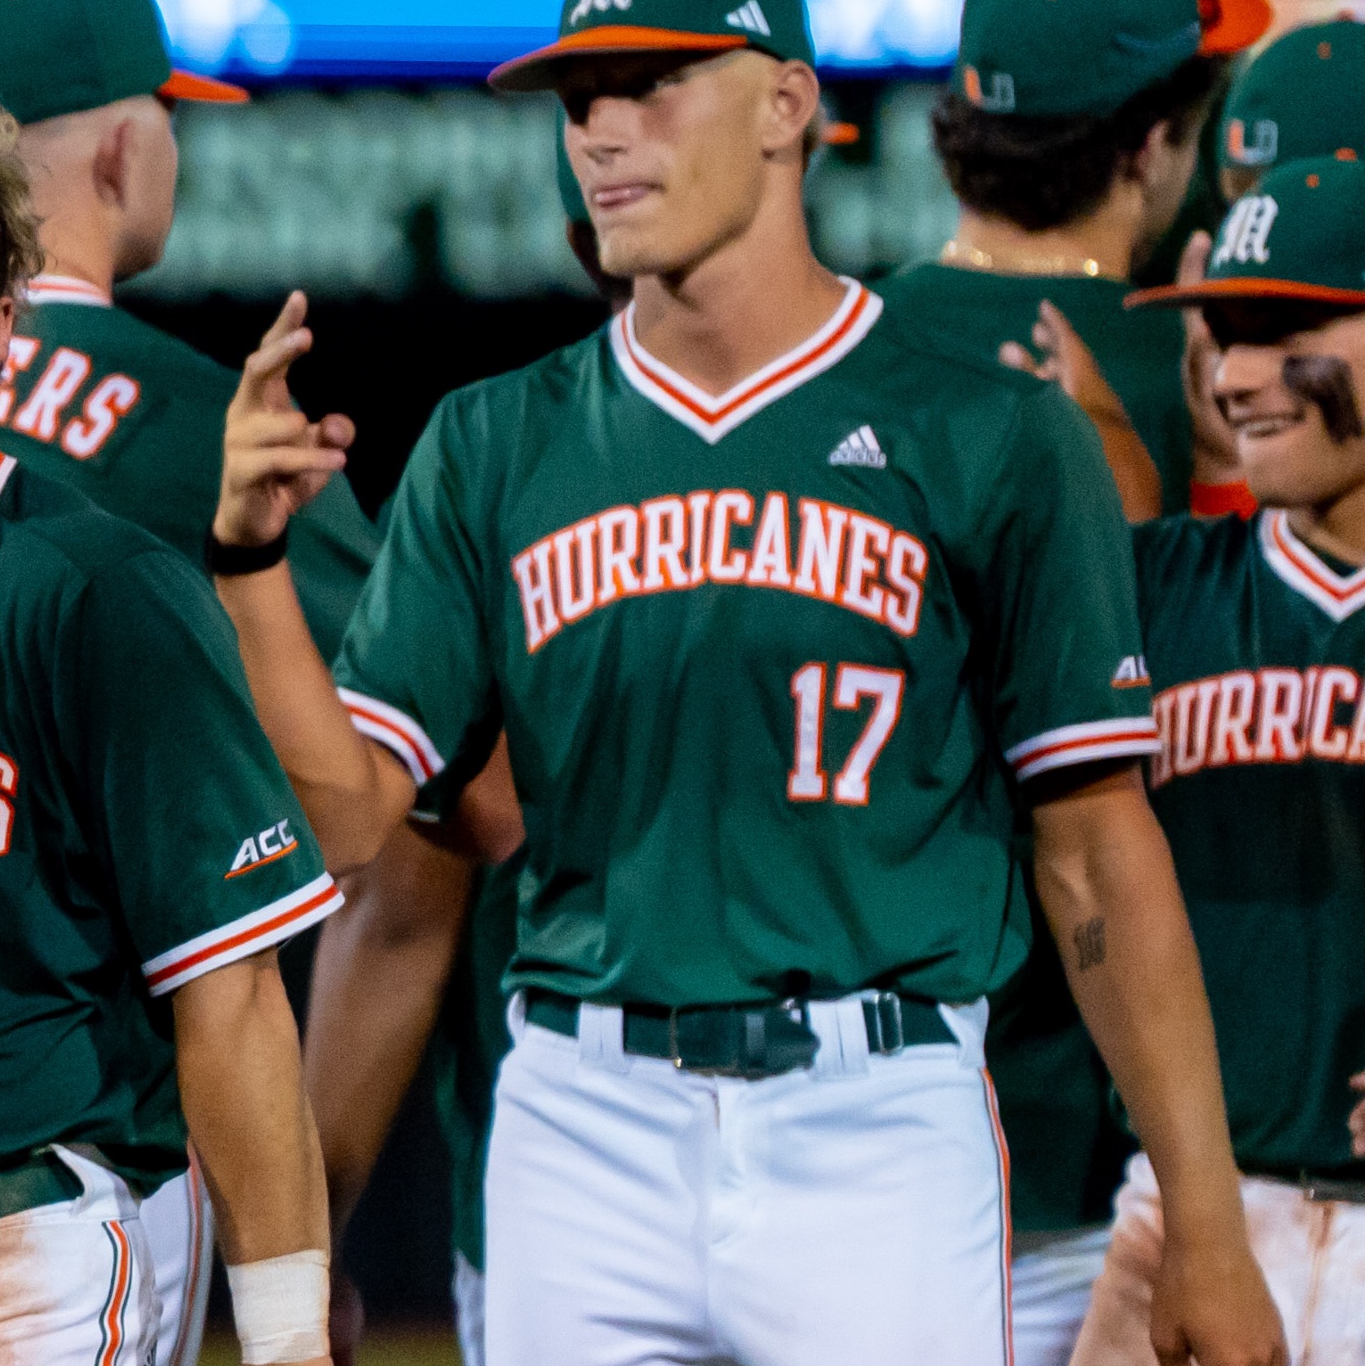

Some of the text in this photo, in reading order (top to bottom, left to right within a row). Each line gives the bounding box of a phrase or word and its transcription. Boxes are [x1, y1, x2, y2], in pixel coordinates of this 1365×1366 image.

[510, 487, 931, 656] HURRICANES
[787, 661, 906, 806] 17
[230, 818, 295, 872] ACC
